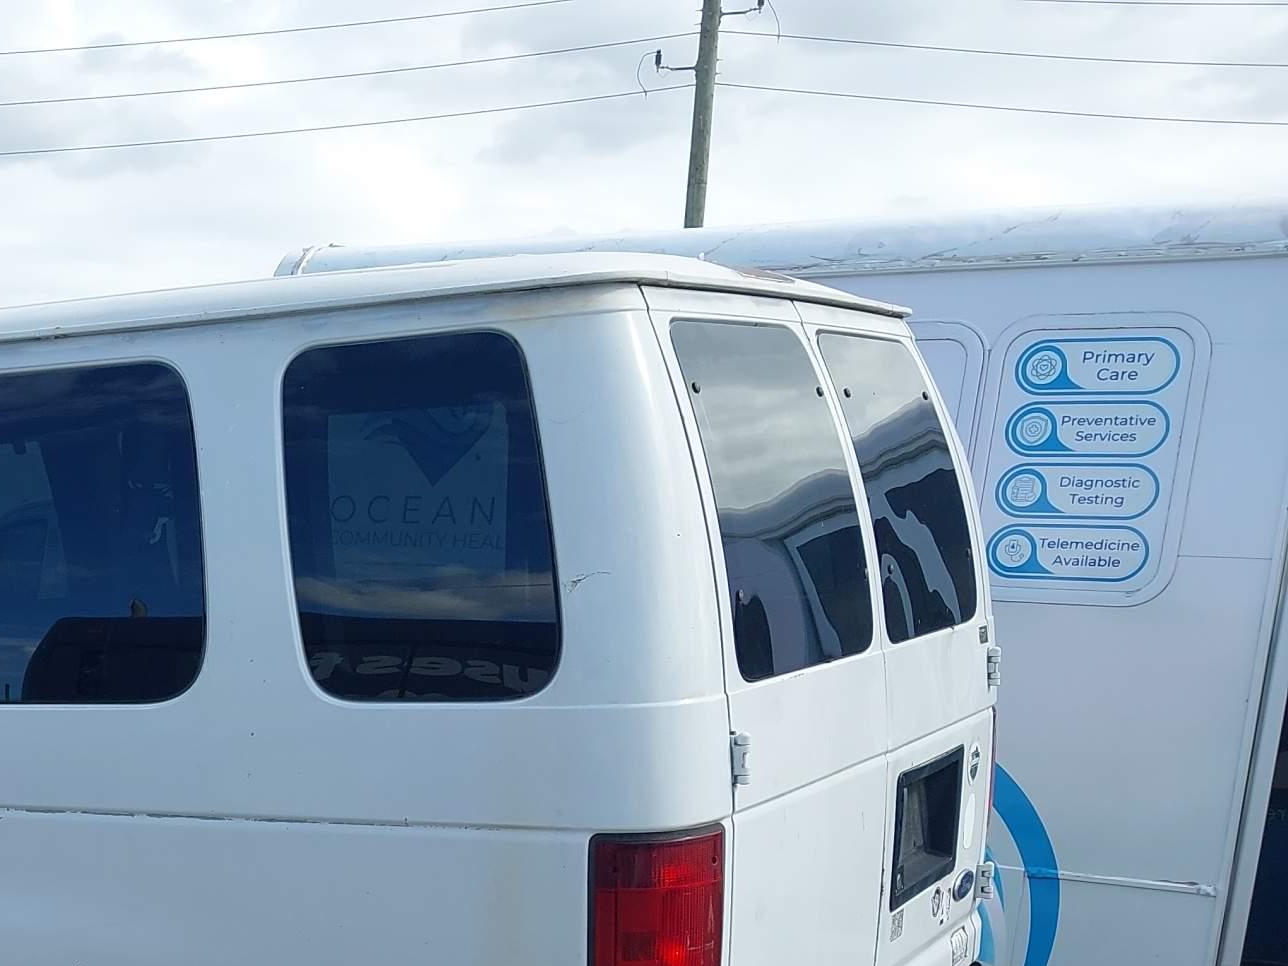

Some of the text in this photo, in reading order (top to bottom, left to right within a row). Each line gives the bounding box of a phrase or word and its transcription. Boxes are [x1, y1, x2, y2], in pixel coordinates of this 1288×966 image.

[1082, 350, 1155, 366] Primary
[1096, 368, 1138, 381] Care
[1061, 415, 1157, 426] Preventative
[1074, 430, 1137, 442] Services
[1059, 476, 1141, 490] Diagnostic
[1069, 493, 1125, 507] Testing
[330, 495, 495, 526] OCEAN
[1039, 537, 1140, 551] Telemedicine
[1052, 555, 1121, 567] Available
